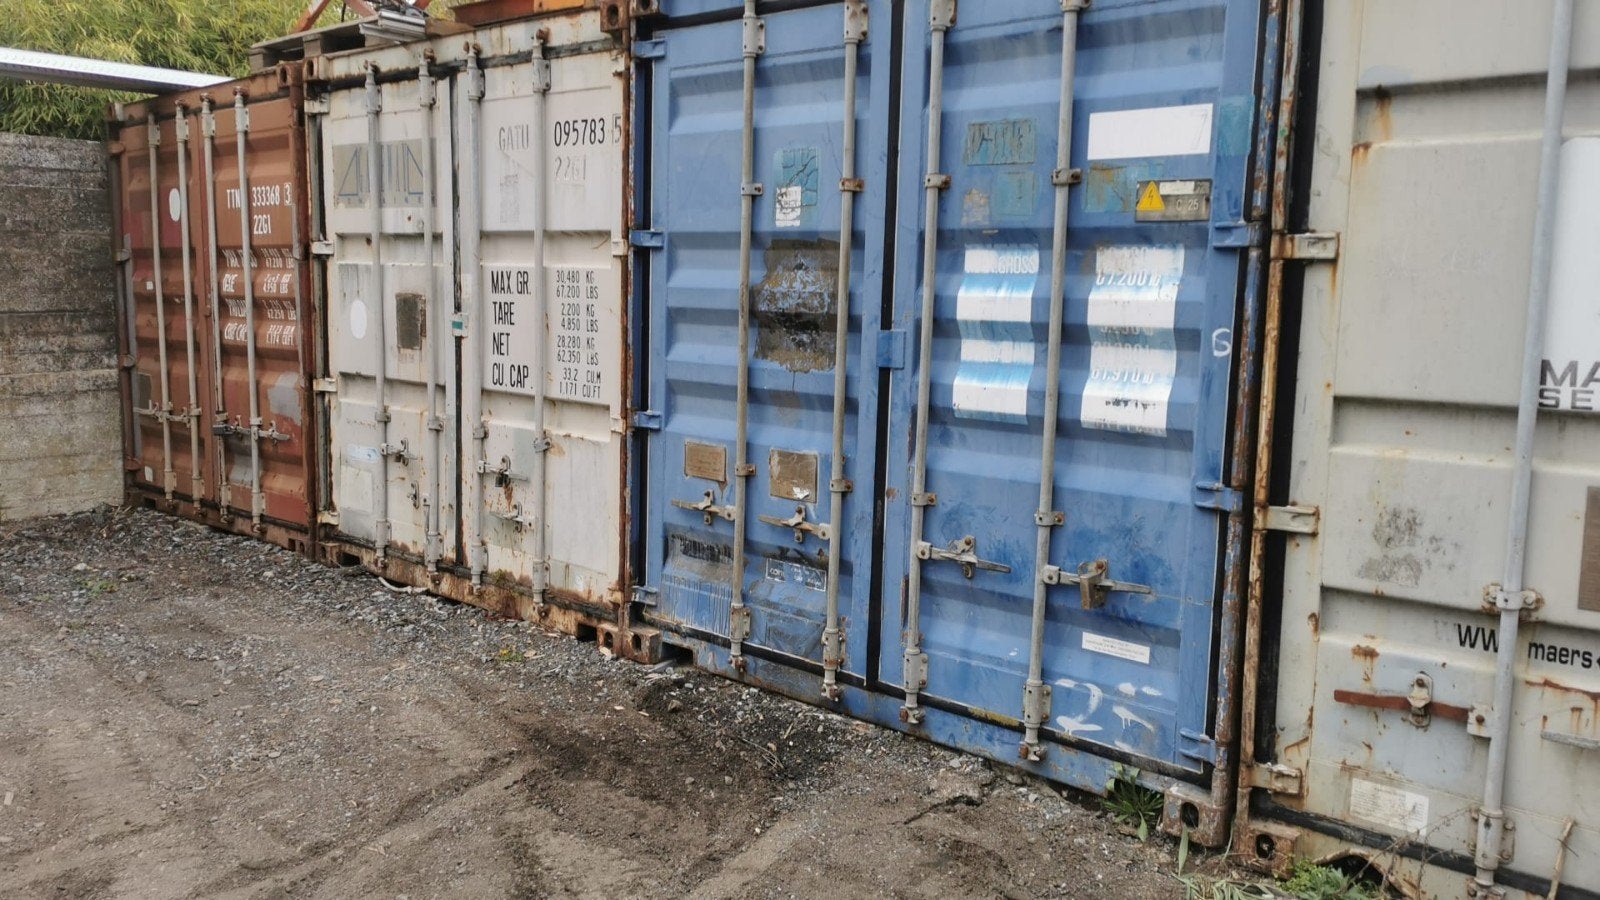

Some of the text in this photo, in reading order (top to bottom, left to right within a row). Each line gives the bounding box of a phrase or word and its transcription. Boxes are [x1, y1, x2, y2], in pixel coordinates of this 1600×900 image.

[554, 117, 605, 147] 095783
[252, 185, 281, 206] 333368
[516, 270, 532, 295] GR.
[586, 286, 599, 300] LBS
[492, 301, 515, 326] TARE
[586, 319, 599, 333] LBS
[492, 332, 511, 357] NET
[587, 352, 599, 366] LBS
[1538, 388, 1594, 410] SE
[1528, 640, 1594, 670] maers
